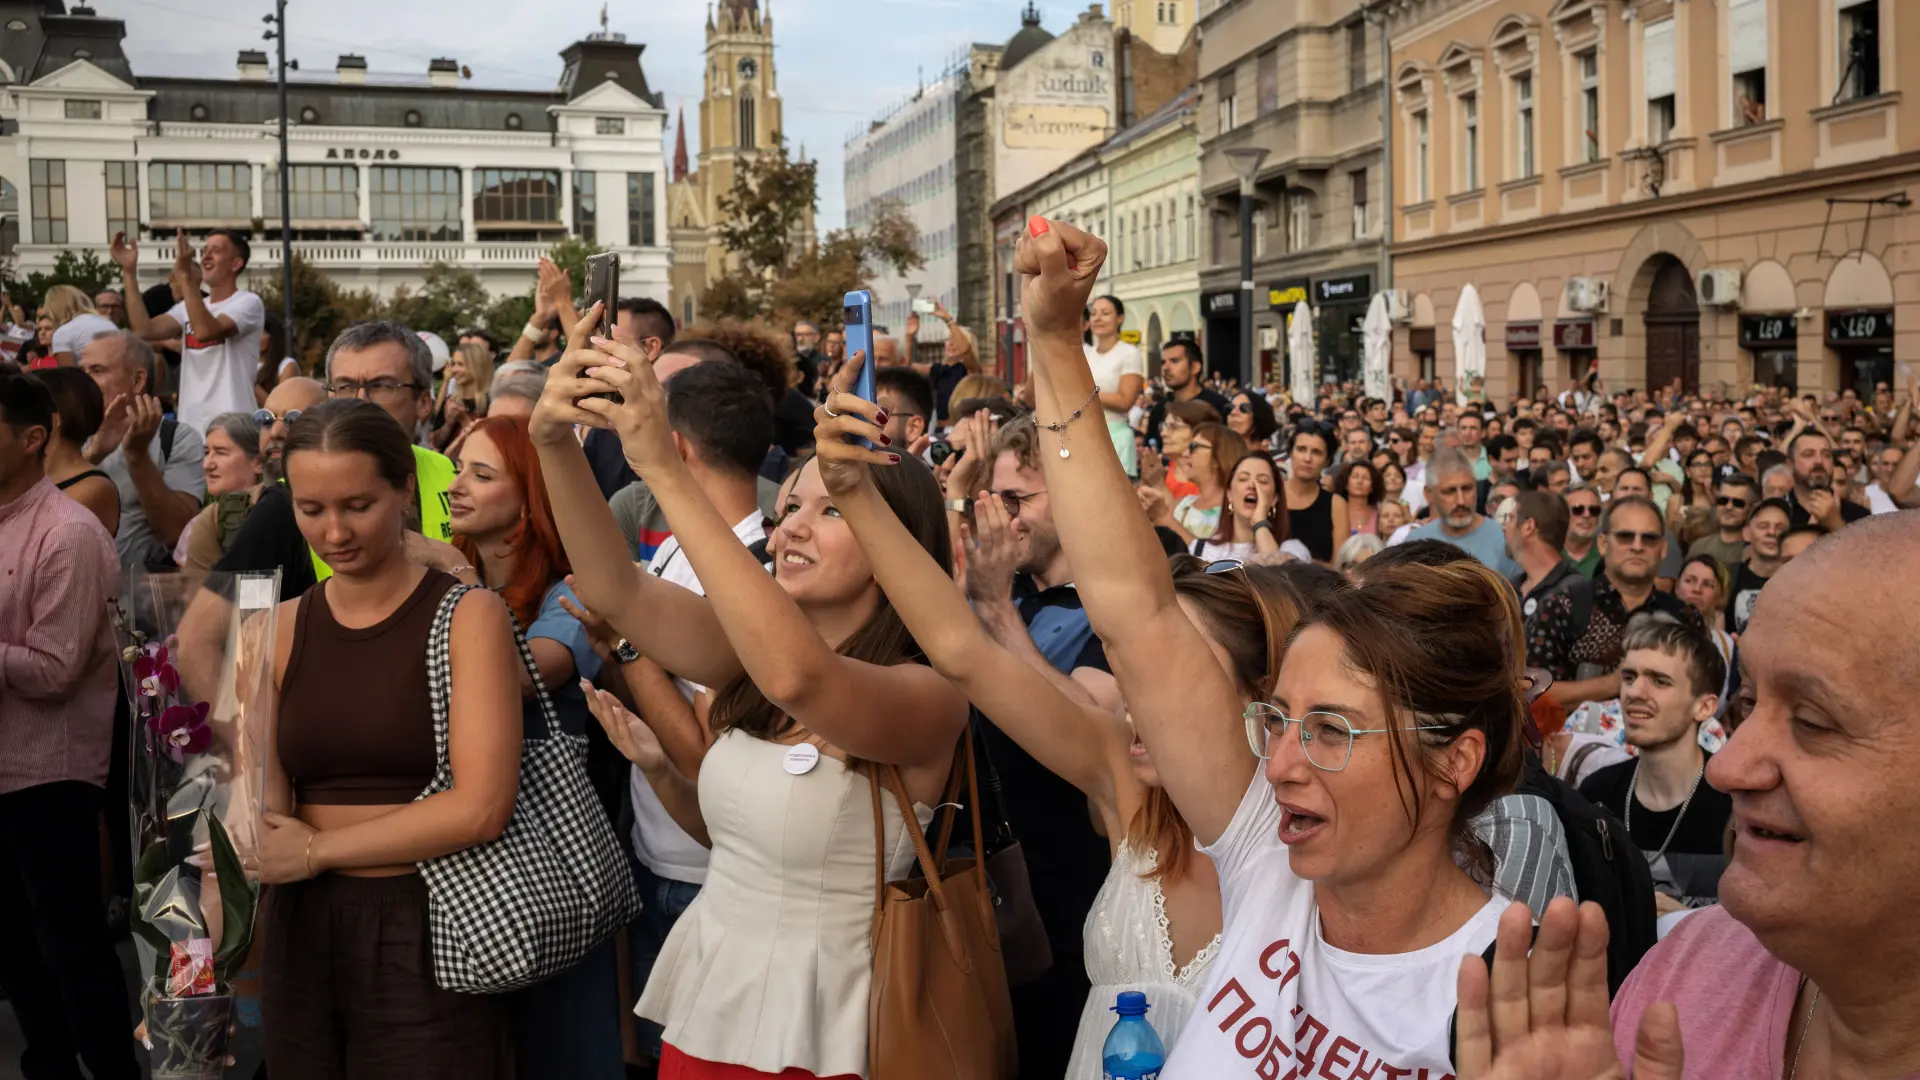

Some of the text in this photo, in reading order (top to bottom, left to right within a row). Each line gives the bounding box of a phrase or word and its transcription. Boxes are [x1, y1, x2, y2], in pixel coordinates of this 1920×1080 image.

[1035, 73, 1108, 95] Rudnik
[326, 148, 399, 160] АПОЛО
[1758, 319, 1783, 339] LEO
[1848, 316, 1876, 338] LEO
[1207, 976, 1298, 1080] ПОБ
